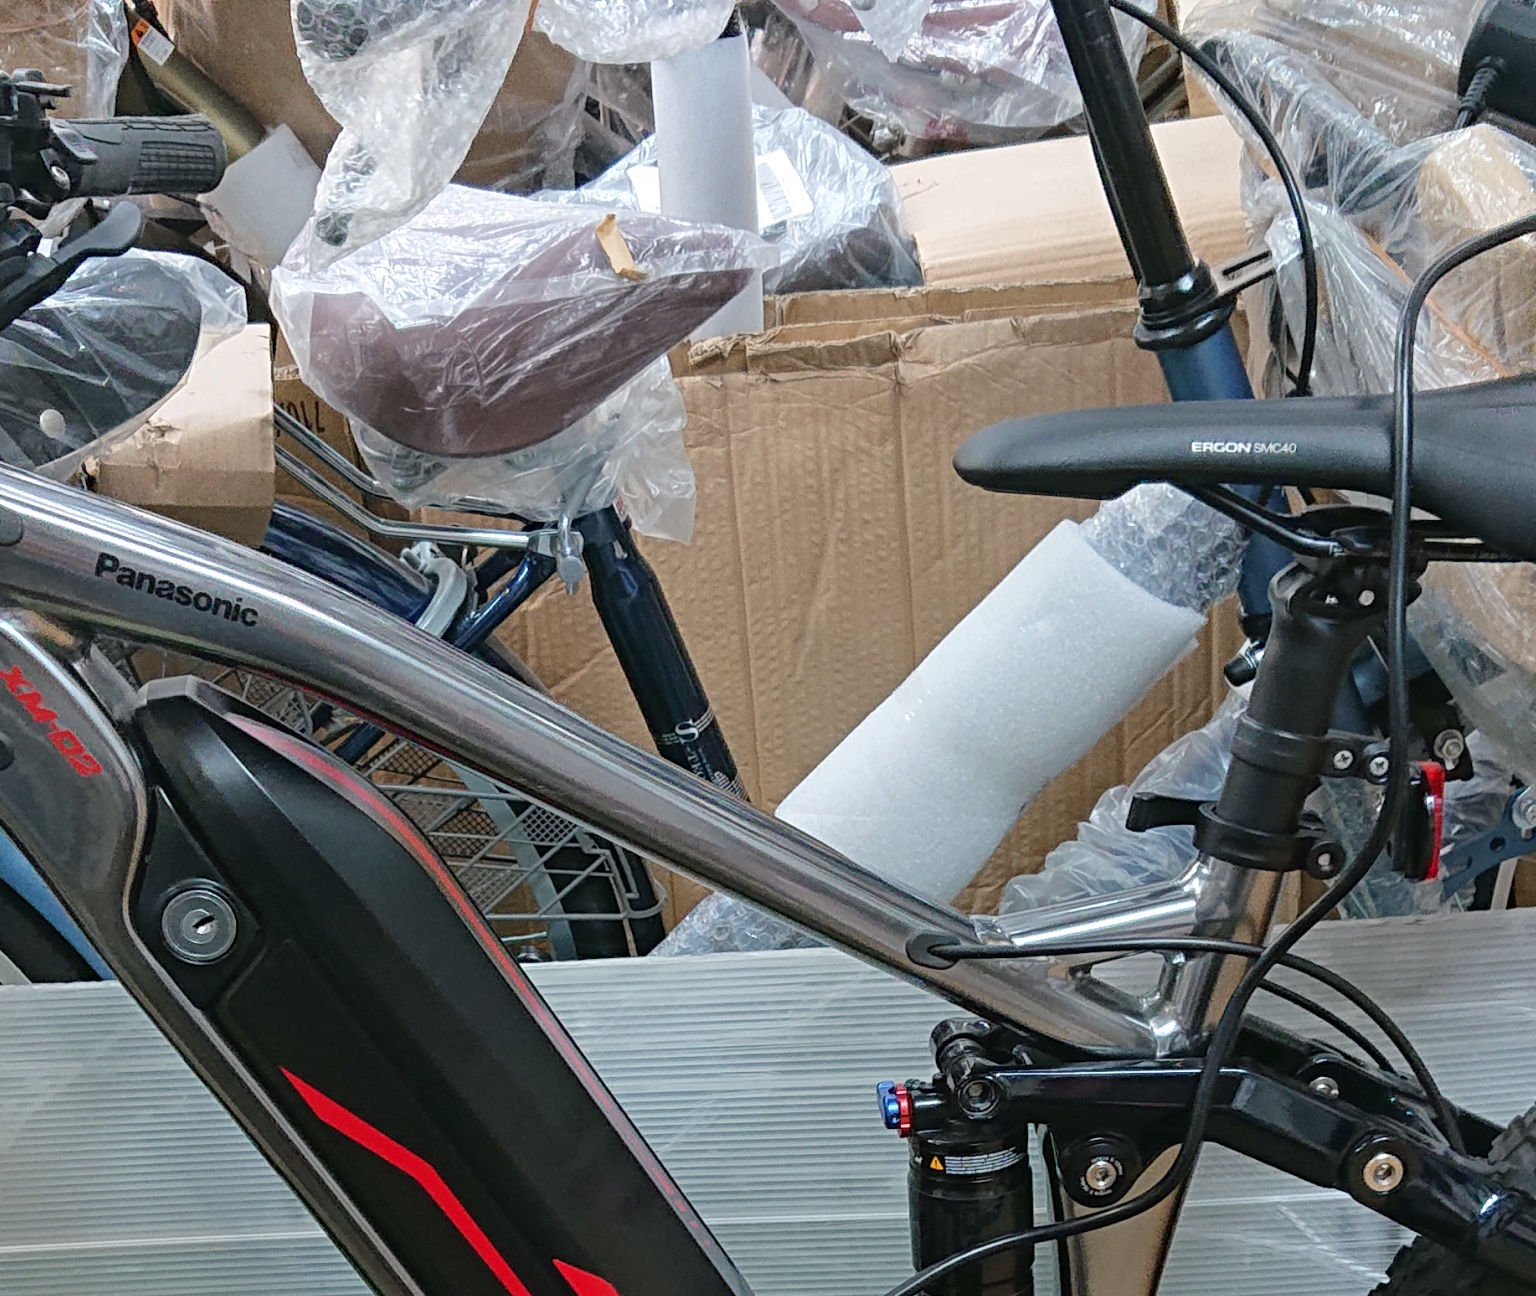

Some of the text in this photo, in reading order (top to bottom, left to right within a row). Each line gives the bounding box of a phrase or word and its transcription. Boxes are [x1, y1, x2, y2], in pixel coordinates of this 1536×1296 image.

[1191, 442, 1297, 453] ERGON SMC40
[94, 552, 259, 627] Panasonic
